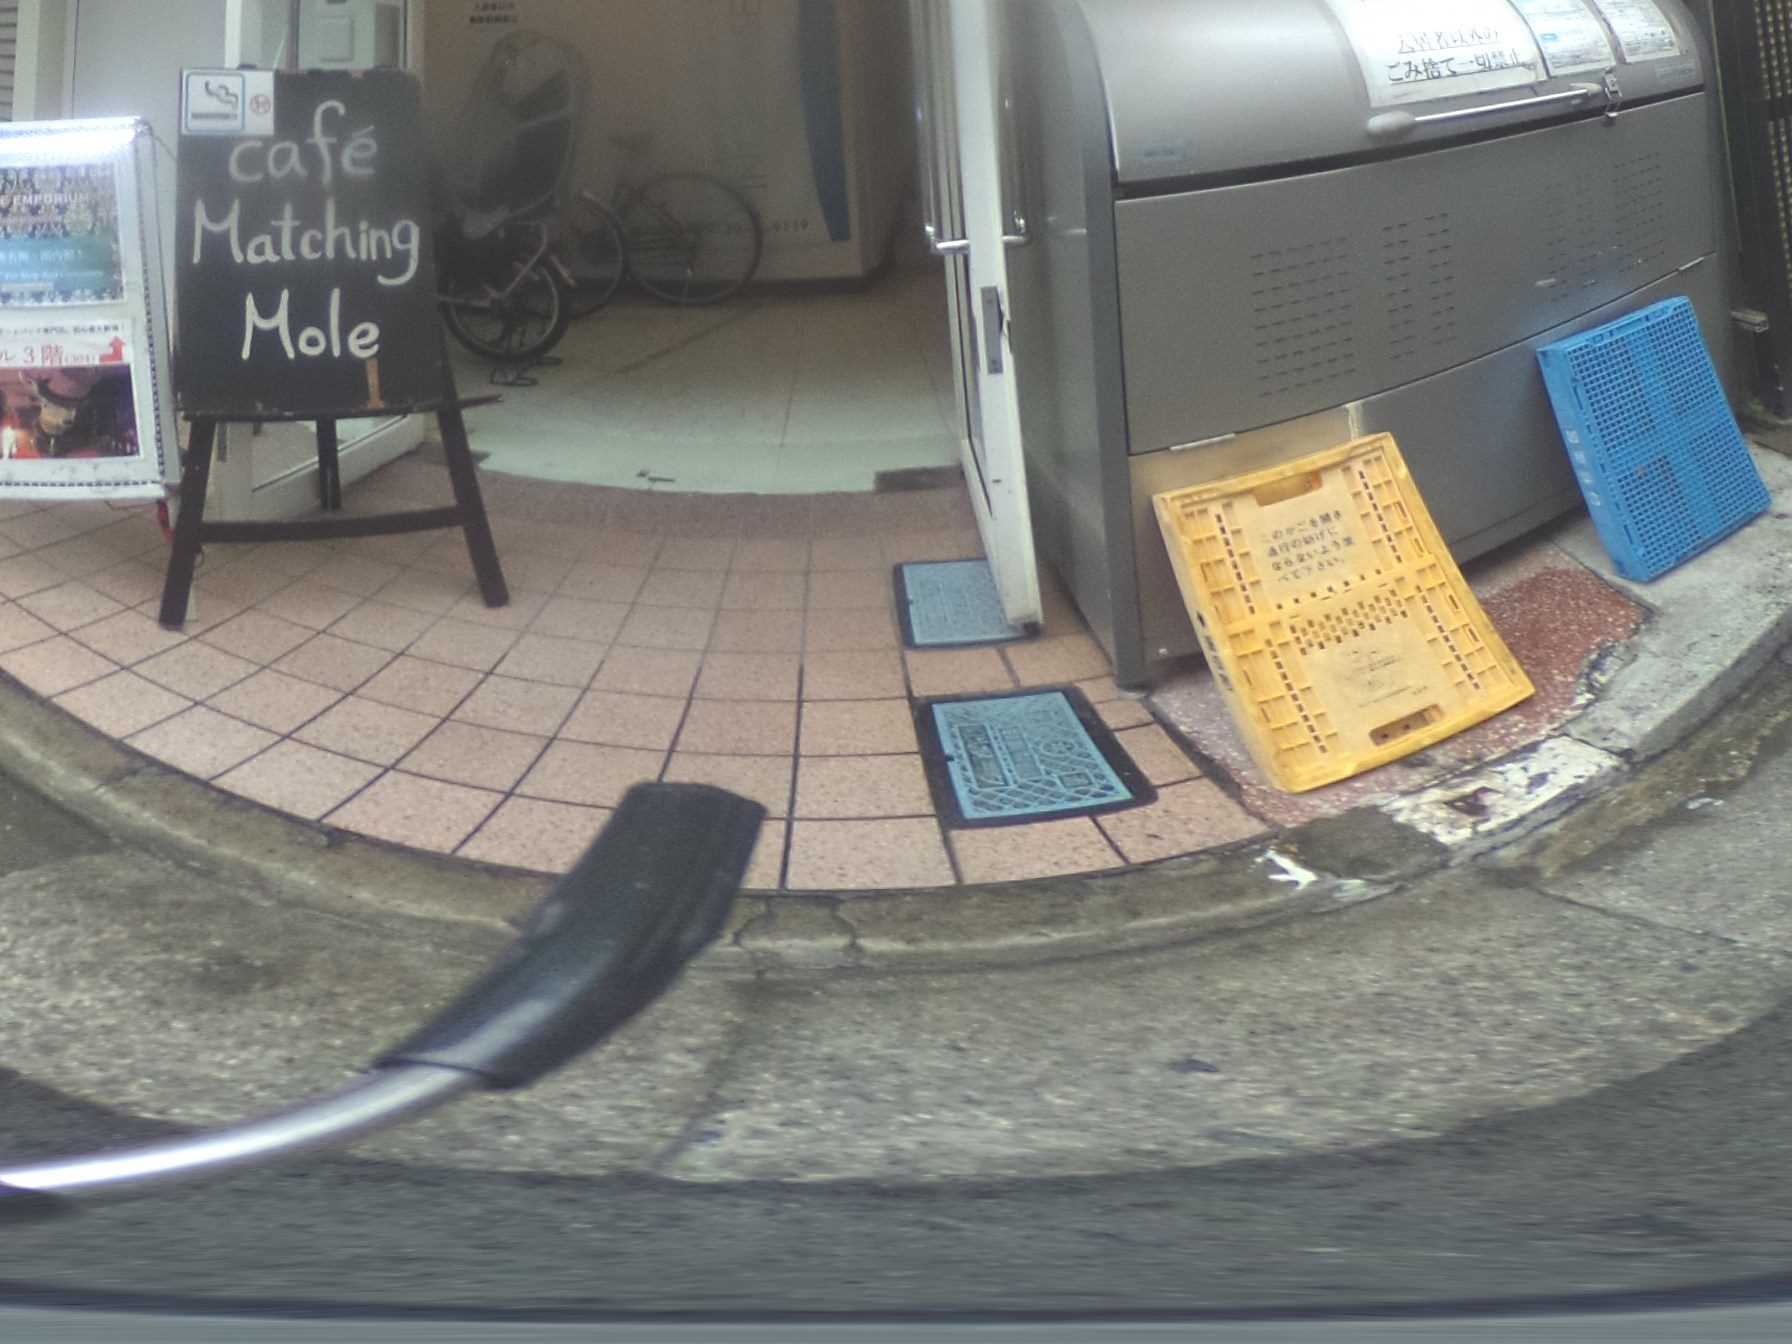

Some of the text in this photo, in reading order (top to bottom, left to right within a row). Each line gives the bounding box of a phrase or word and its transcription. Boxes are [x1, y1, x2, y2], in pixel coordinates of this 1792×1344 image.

[229, 100, 377, 186] café
[193, 198, 420, 285] Matching
[241, 288, 380, 360] Mole
